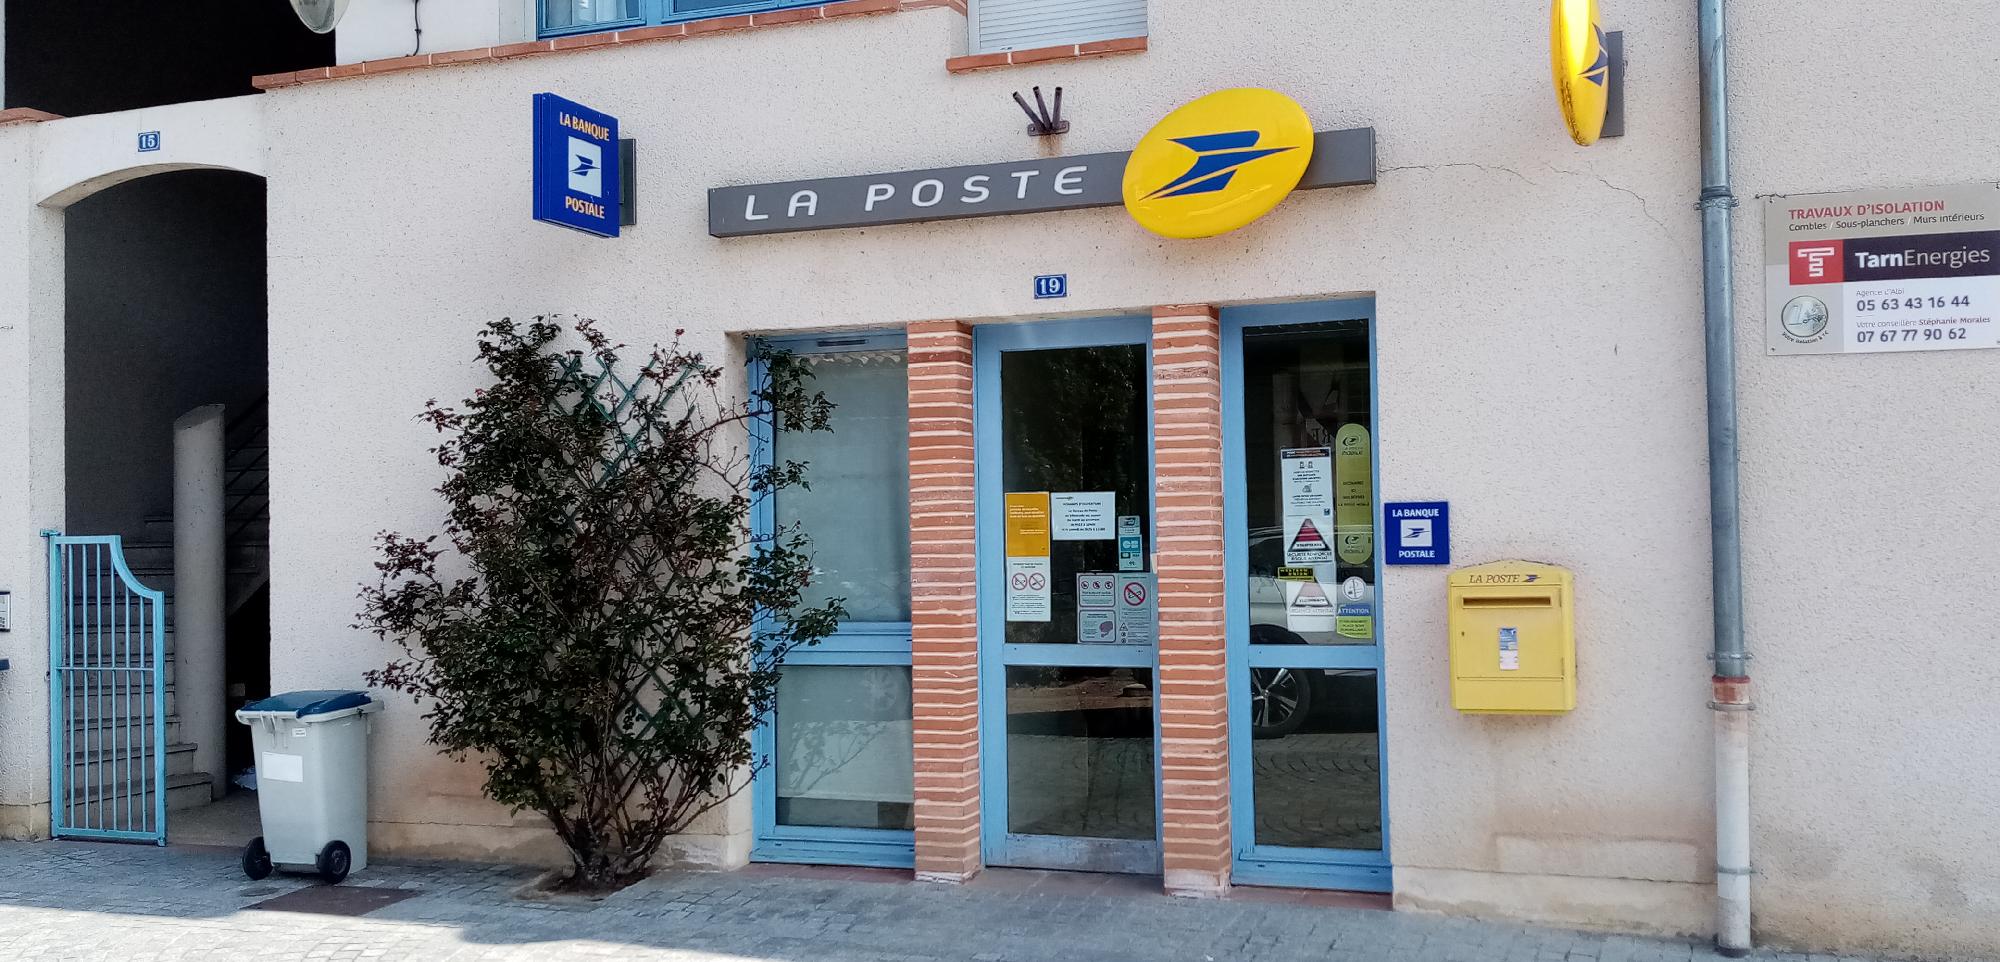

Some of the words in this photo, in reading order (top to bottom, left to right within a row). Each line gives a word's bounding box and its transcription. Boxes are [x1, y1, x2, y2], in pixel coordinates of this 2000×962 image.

[560, 111, 571, 128] LA
[572, 116, 610, 141] BANQUE
[142, 135, 155, 148] 15
[745, 190, 818, 221] LA
[865, 166, 1088, 211] POSTE
[565, 196, 605, 219] POSTALE
[1789, 206, 1853, 220] TRAVAUX
[1858, 200, 1945, 216] D'ISOLATION
[1789, 222, 1827, 232] Combles
[1836, 217, 1905, 230] Sous-planchers
[1913, 216, 1937, 225] Murs
[1940, 212, 1985, 223] intérieurs
[1855, 246, 1990, 268] TarnEnergies
[1040, 278, 1060, 294] 19
[1857, 299, 1875, 311] 05
[1881, 298, 1899, 310] 63
[1905, 298, 1922, 309] 43
[1929, 296, 1945, 308] 16
[1951, 296, 1970, 307] 44
[1918, 316, 1957, 326] Stéphanie
[1960, 316, 1990, 324] Morales
[1857, 331, 1875, 343] 07
[1880, 330, 1896, 342] 67
[1901, 330, 1918, 341] 77
[1924, 329, 1942, 340] 90
[1948, 328, 1966, 339] 62
[1404, 508, 1439, 518] BANQUE
[1399, 550, 1435, 558] POSTALE
[1469, 575, 1483, 583] LA
[1486, 575, 1520, 583] POSTE
